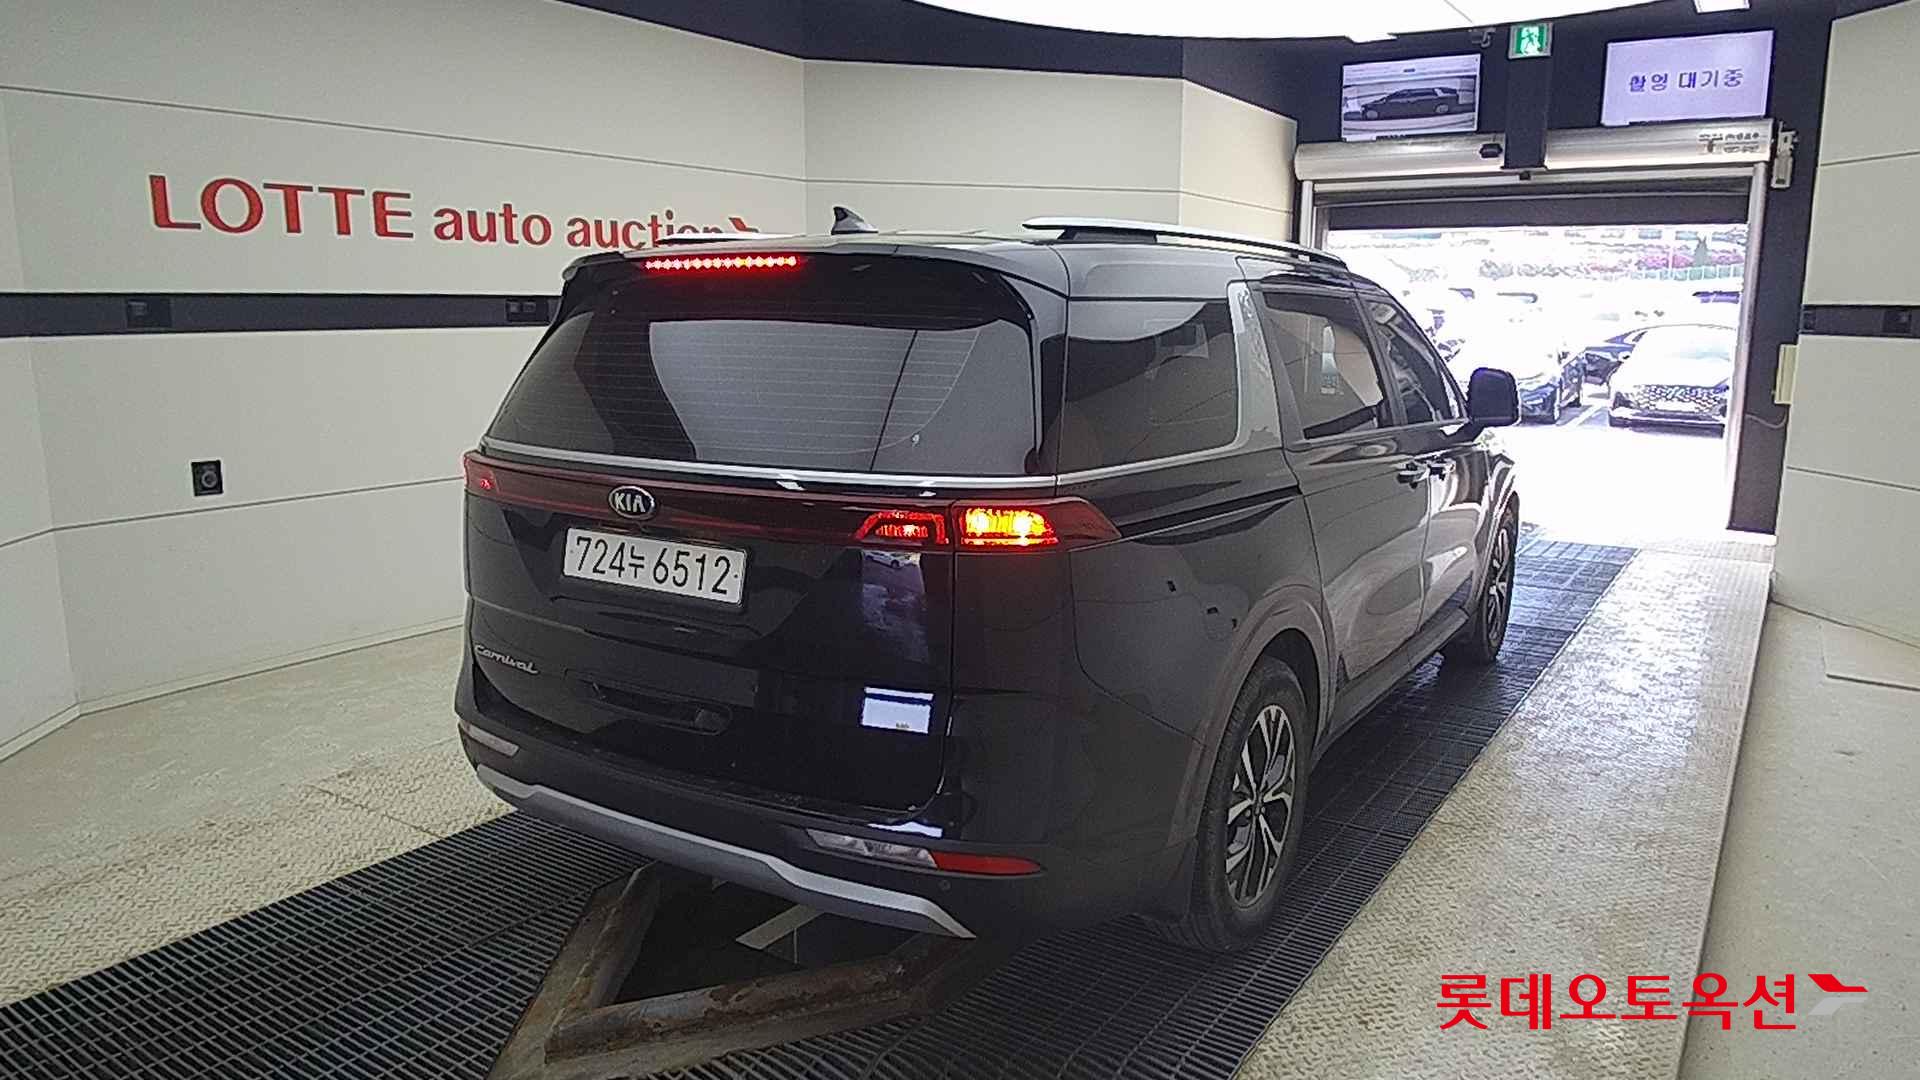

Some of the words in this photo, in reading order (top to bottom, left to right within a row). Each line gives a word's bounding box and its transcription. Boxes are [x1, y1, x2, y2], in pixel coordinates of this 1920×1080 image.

[1678, 68, 1744, 89] 대기중
[149, 174, 414, 239] LOTTE
[433, 203, 552, 246] auto
[566, 209, 725, 250] aucti
[613, 491, 647, 514] KIA
[474, 644, 539, 674] Carnival
